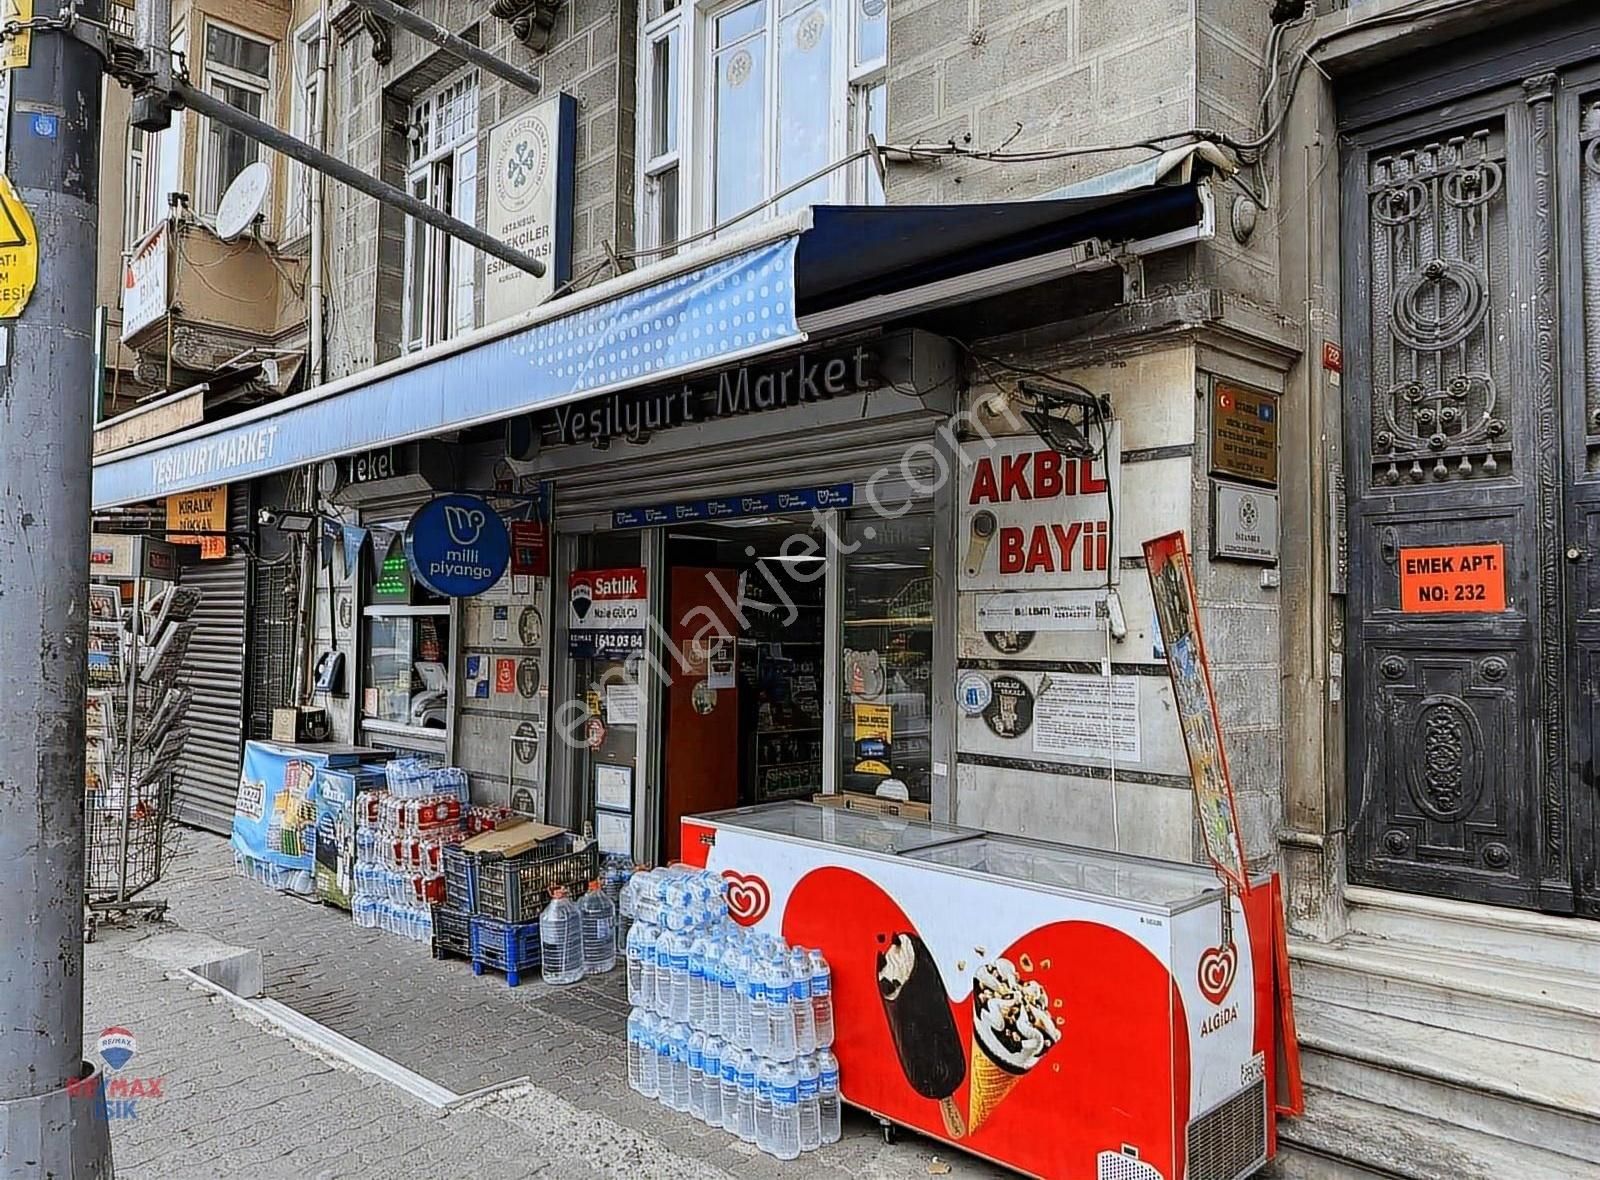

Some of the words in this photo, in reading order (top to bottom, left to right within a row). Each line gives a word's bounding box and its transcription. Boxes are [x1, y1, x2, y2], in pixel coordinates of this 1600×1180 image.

[555, 384, 693, 442] Yeşilyurt
[717, 345, 870, 416] Market
[215, 426, 277, 473] MARKET
[446, 549, 479, 562] milli
[1406, 557, 1455, 575] EMEK
[1459, 554, 1497, 573] APT.
[429, 560, 493, 580] piyango
[594, 575, 638, 595] Satılık
[1418, 585, 1449, 602] NO:
[1454, 583, 1486, 601] 232
[630, 634, 643, 648] 84
